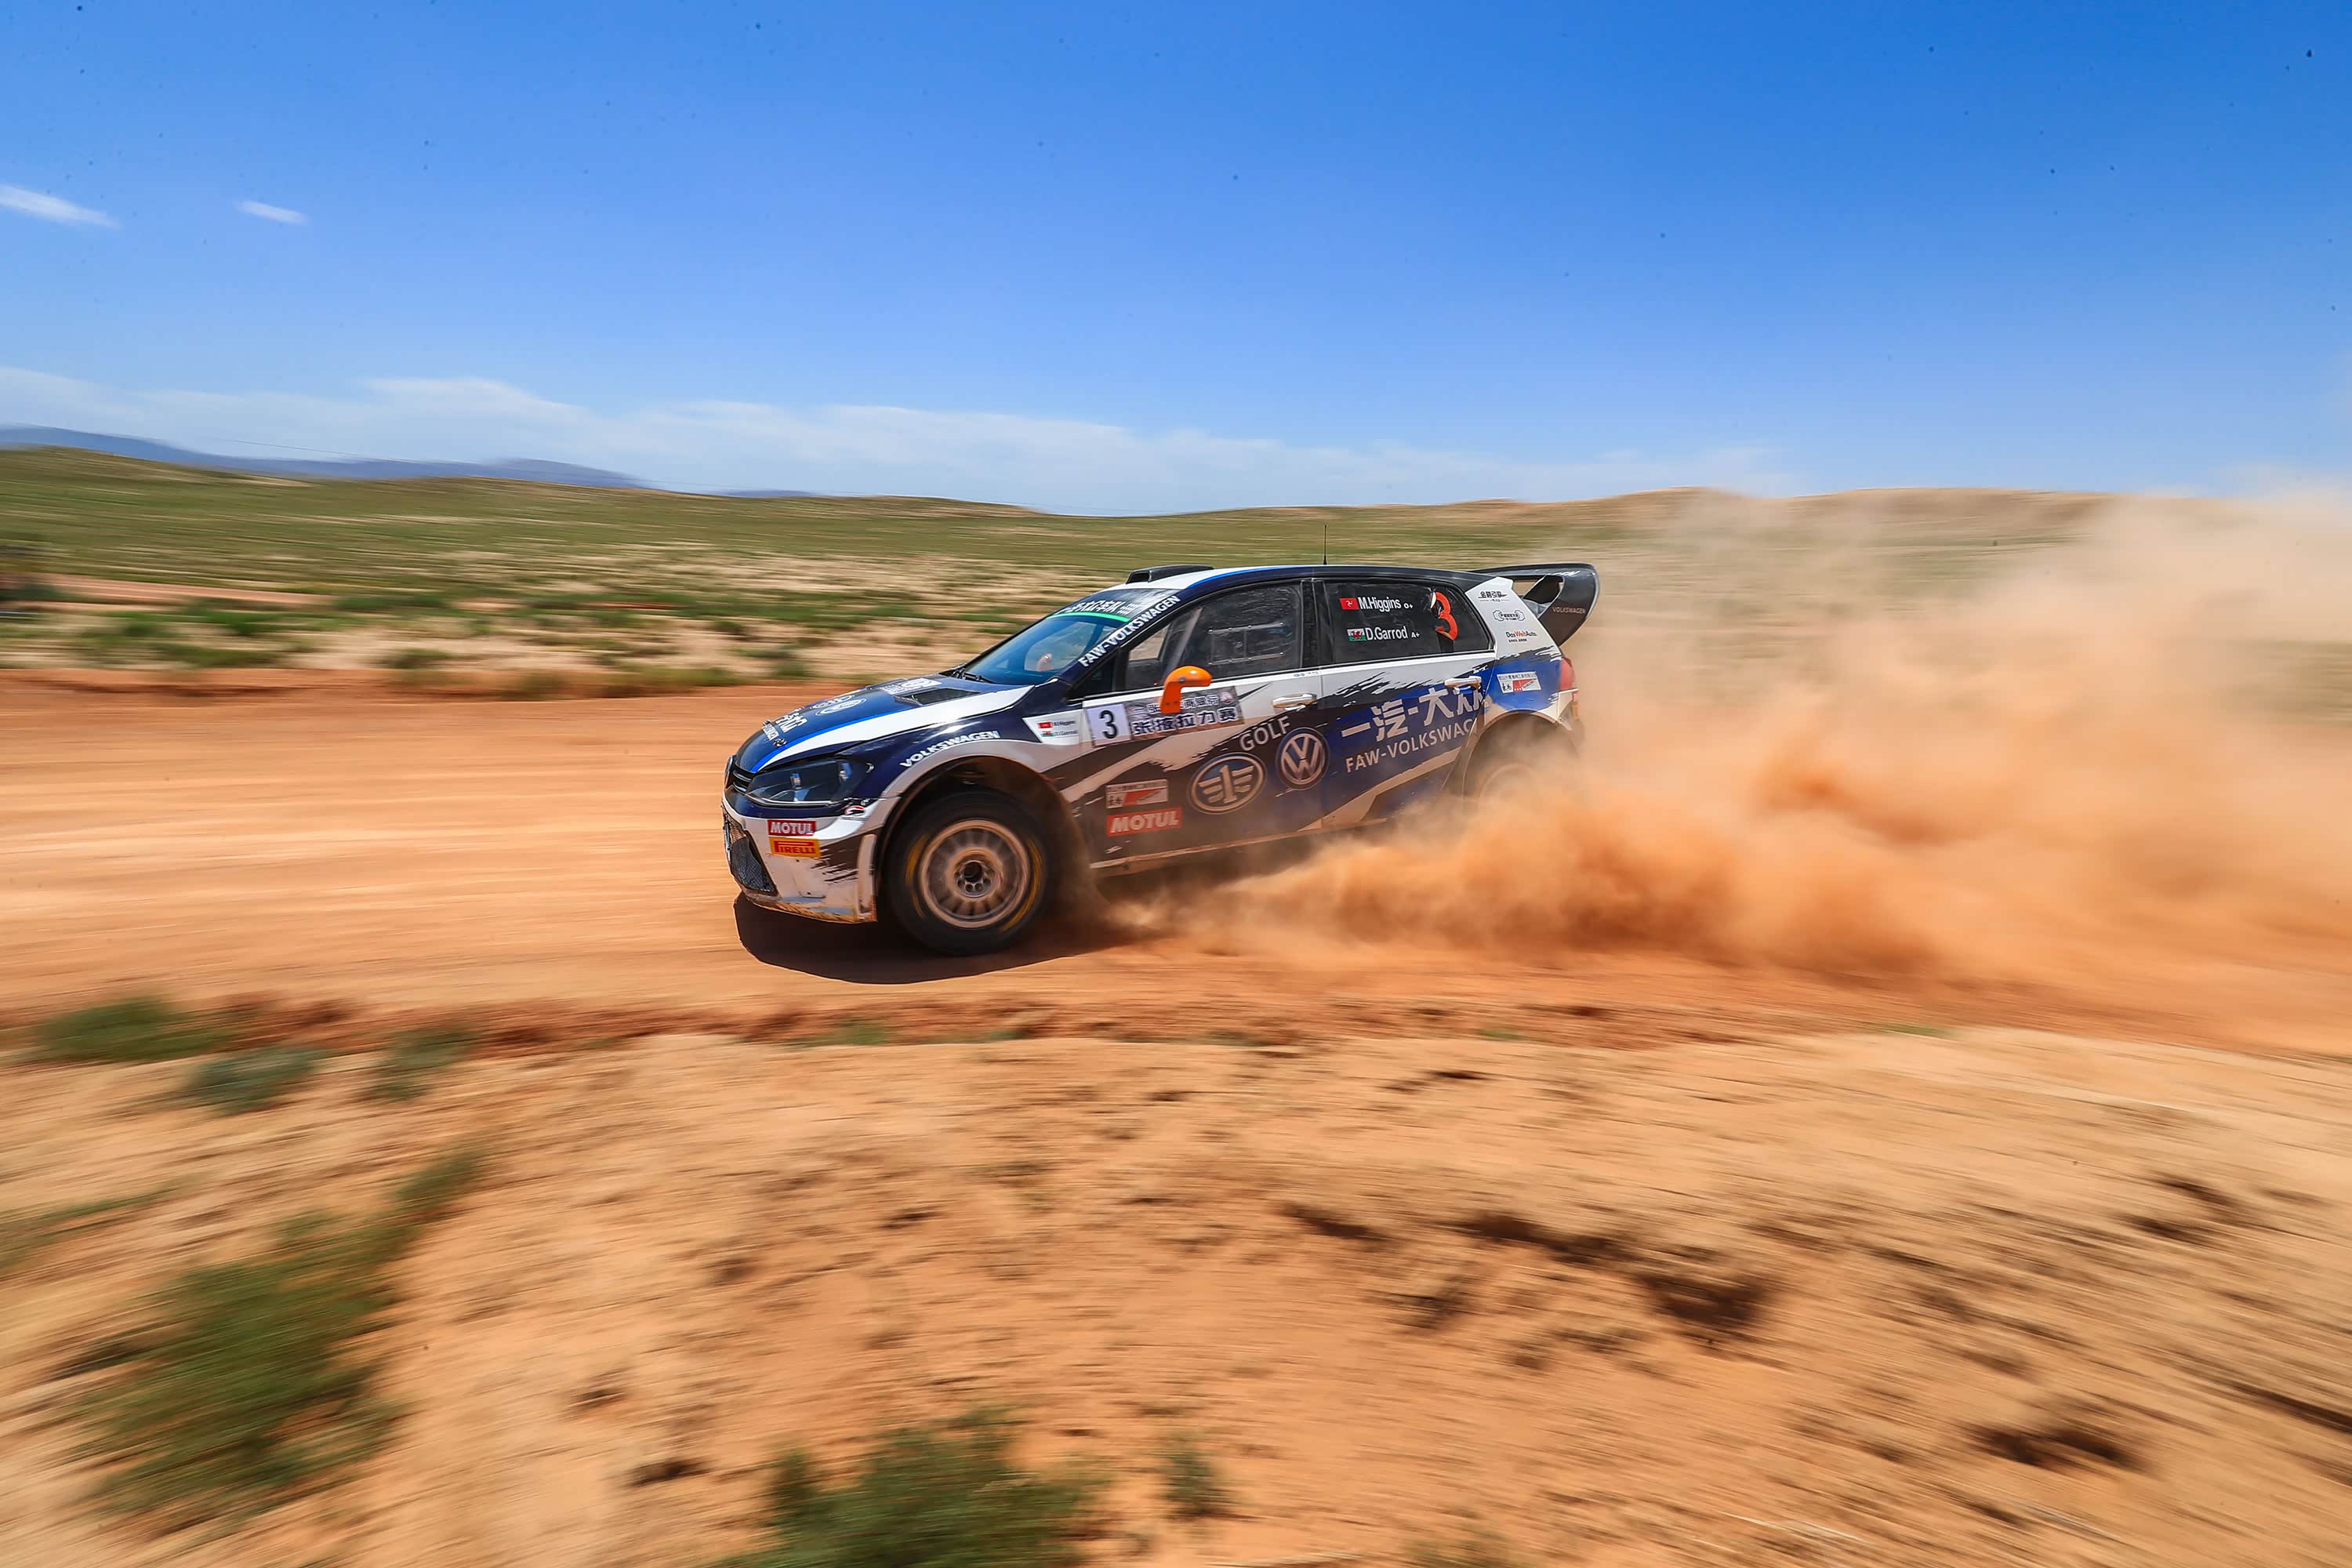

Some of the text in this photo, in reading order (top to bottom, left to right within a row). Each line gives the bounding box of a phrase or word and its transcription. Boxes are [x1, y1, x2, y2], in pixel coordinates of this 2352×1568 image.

[1358, 597, 1401, 612] M.Higgins
[1552, 606, 1585, 615] VOLKSWAGEN
[1078, 596, 1181, 666] FAW-VOLKSWAGEN
[1367, 626, 1408, 641] D.Garrod
[1099, 710, 1118, 739] 3
[1131, 707, 1239, 736] 张掖拉力赛
[1240, 715, 1290, 751] GOLF
[899, 730, 1001, 768] VOLKSWAGEN
[770, 821, 813, 834] MOTUL
[1110, 810, 1180, 833] MOTUL
[773, 840, 815, 854] PIRELLI
